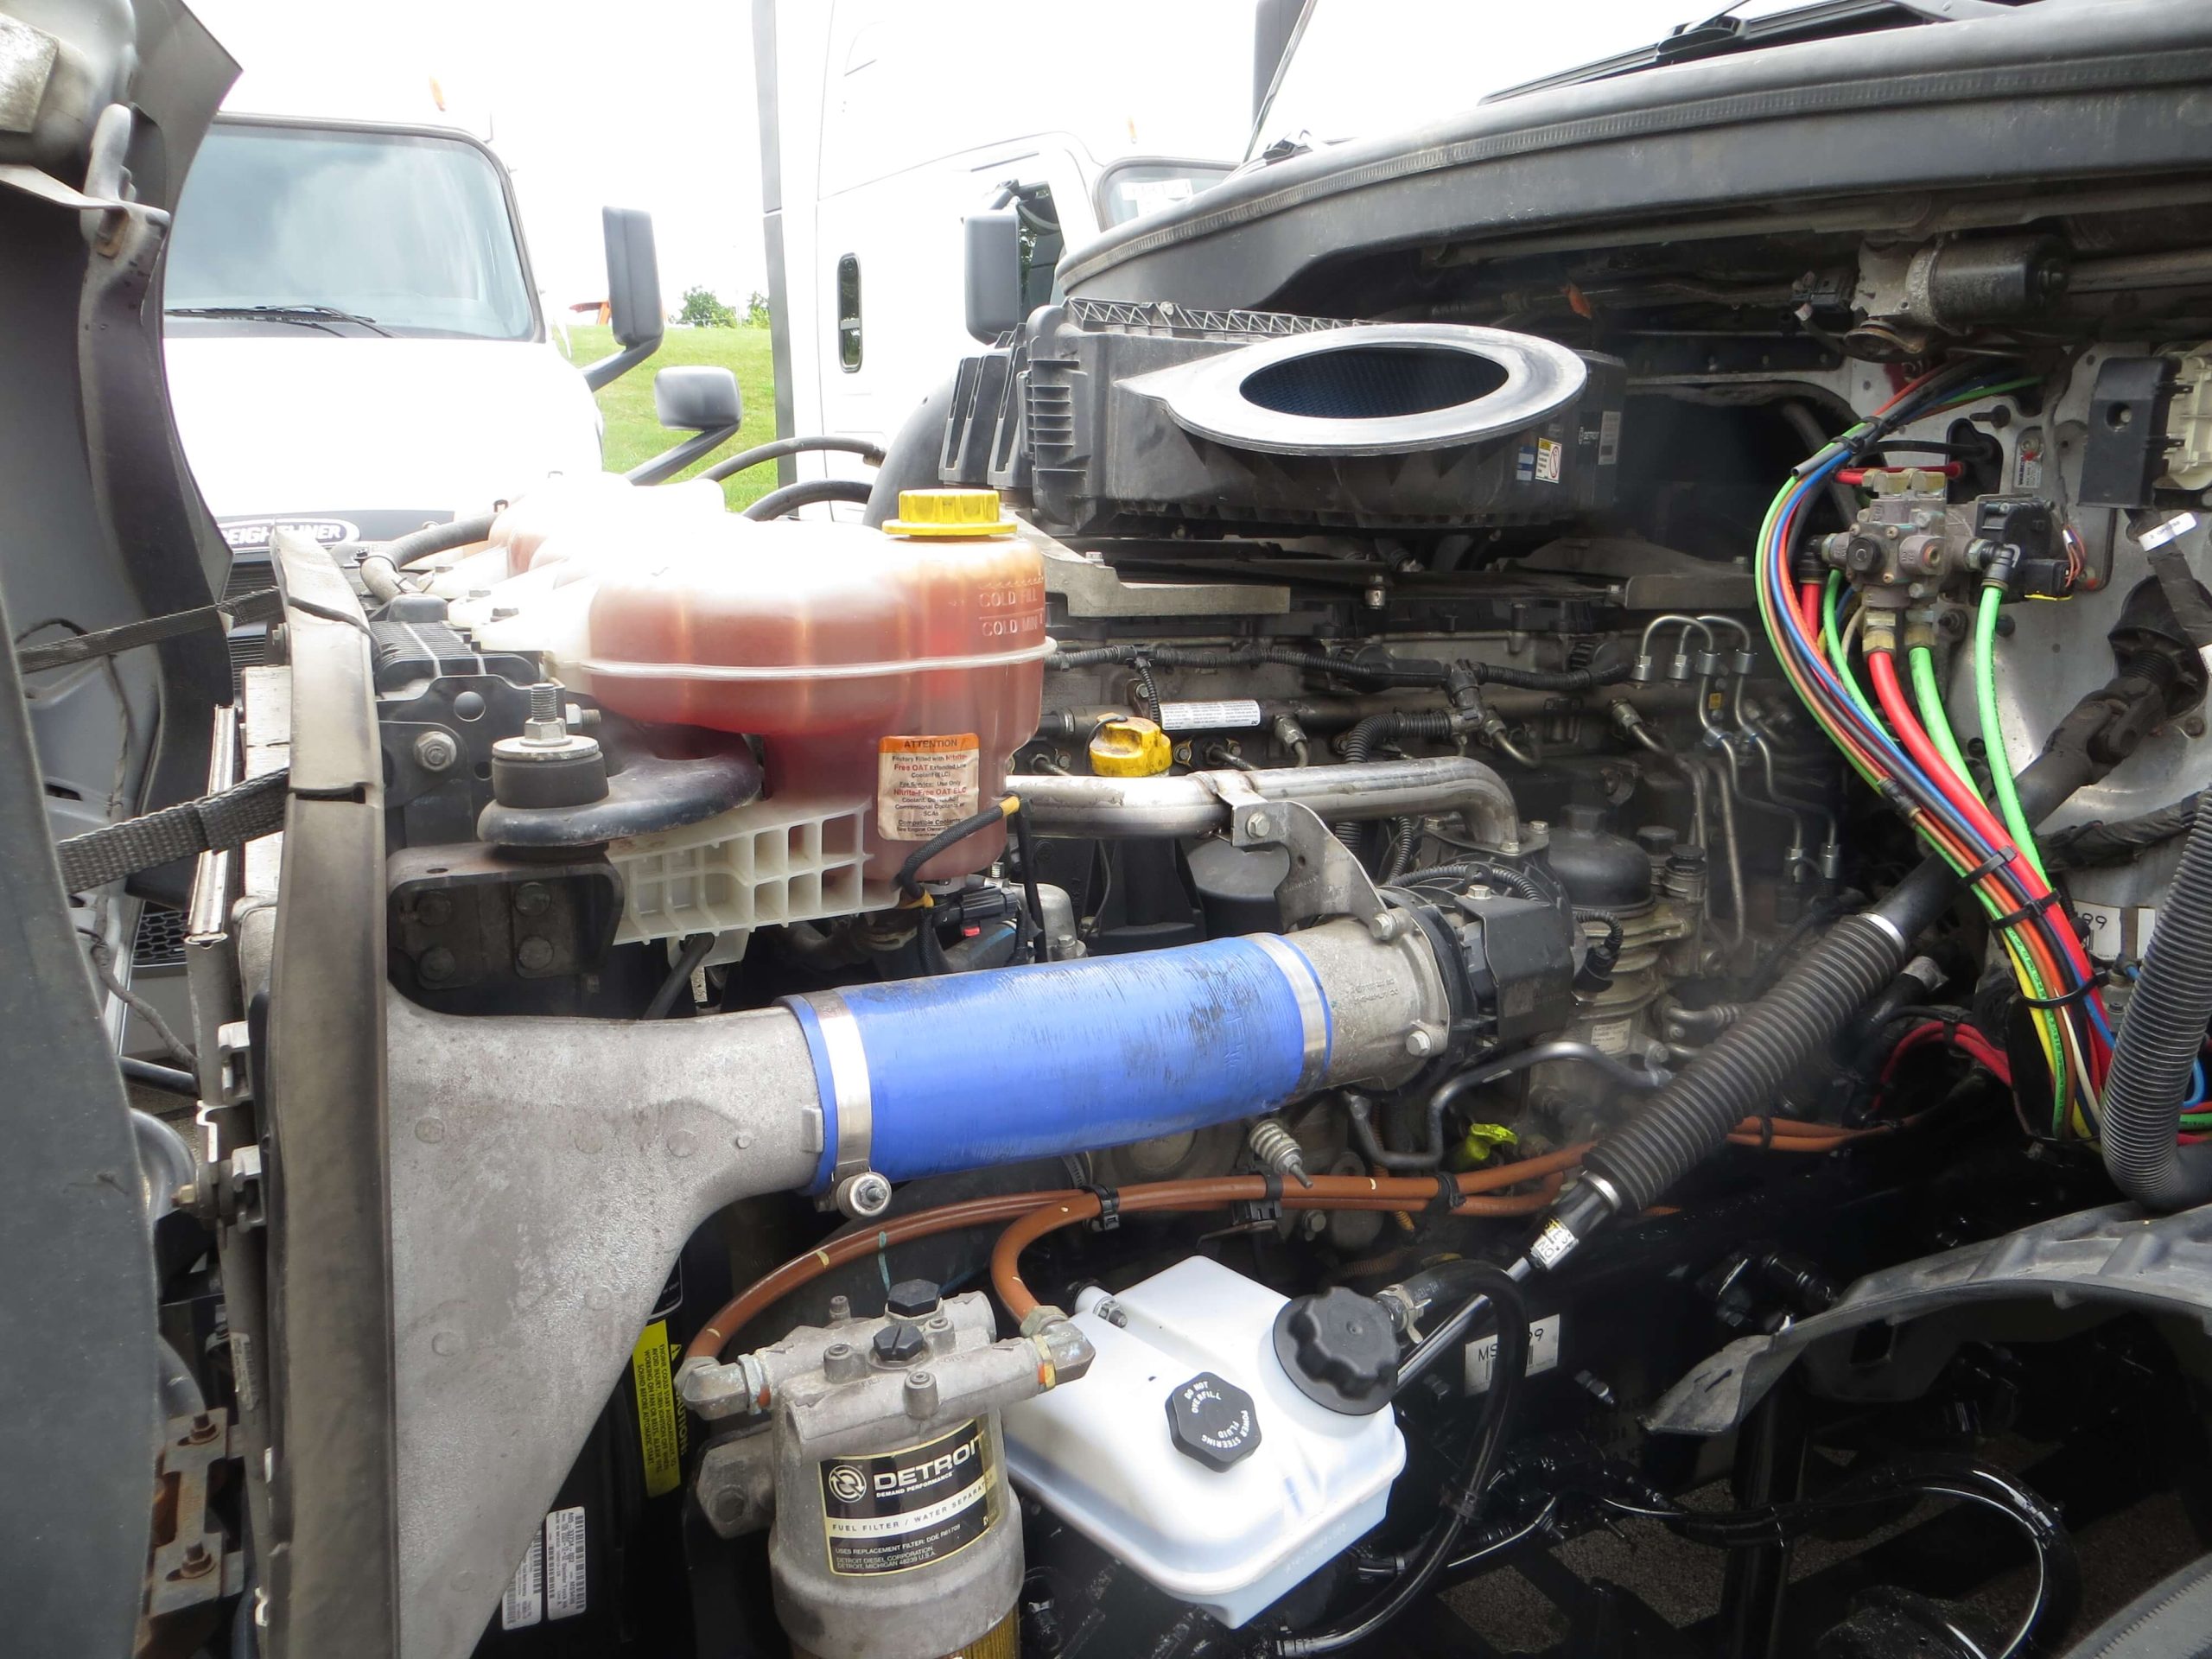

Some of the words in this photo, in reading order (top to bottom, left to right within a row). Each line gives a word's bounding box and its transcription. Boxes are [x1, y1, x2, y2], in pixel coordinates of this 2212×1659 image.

[980, 591, 1016, 607] COLD
[982, 619, 1017, 636] COLD
[905, 739, 957, 748] ATTENTION
[644, 1350, 653, 1381] WORKING
[648, 1382, 655, 1393] ON
[1184, 1388, 1194, 1400] DO
[1193, 1381, 1209, 1391] NOT
[1192, 1390, 1222, 1414] OVERFILL
[1217, 1421, 1240, 1439] FLUID
[1239, 1409, 1250, 1437] POWER
[1201, 1434, 1242, 1449] STEERING
[876, 1488, 905, 1498] DEMAND
[906, 1471, 954, 1493] PERFORMANCE
[832, 1522, 857, 1532] FUEL
[862, 1521, 900, 1531] FILTER
[914, 1506, 948, 1522] WATER
[853, 1545, 900, 1555] REPLACEMENT
[902, 1539, 925, 1550] FILTER:
[887, 1547, 933, 1561] CORPORATION
[866, 1560, 899, 1569] MICHIGAN
